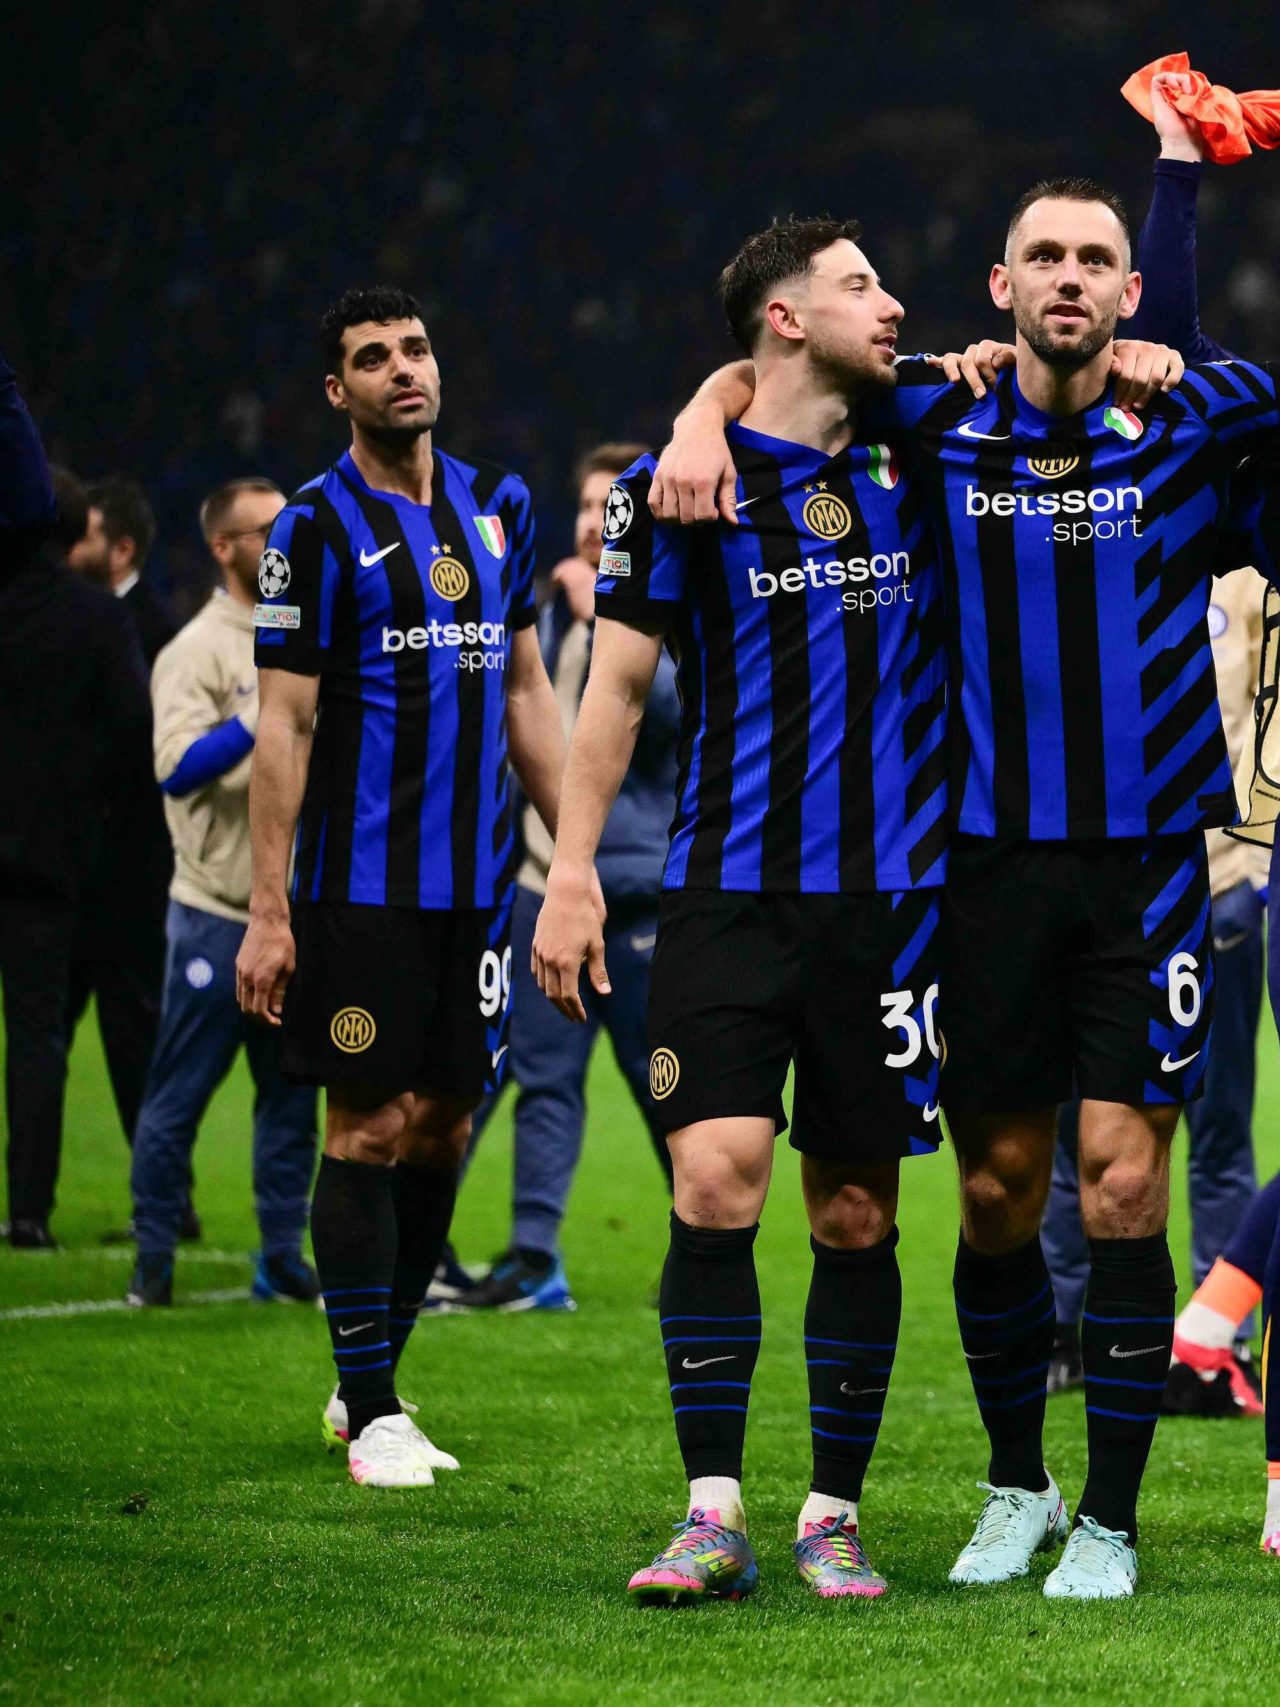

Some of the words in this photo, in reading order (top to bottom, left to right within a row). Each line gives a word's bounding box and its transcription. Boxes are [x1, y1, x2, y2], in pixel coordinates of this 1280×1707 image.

[966, 484, 1143, 516] betsson
[1045, 514, 1144, 546] .sport
[748, 551, 910, 599] betsson
[836, 579, 914, 614] .sport
[382, 619, 505, 653] betsson
[1167, 951, 1201, 1027] 6
